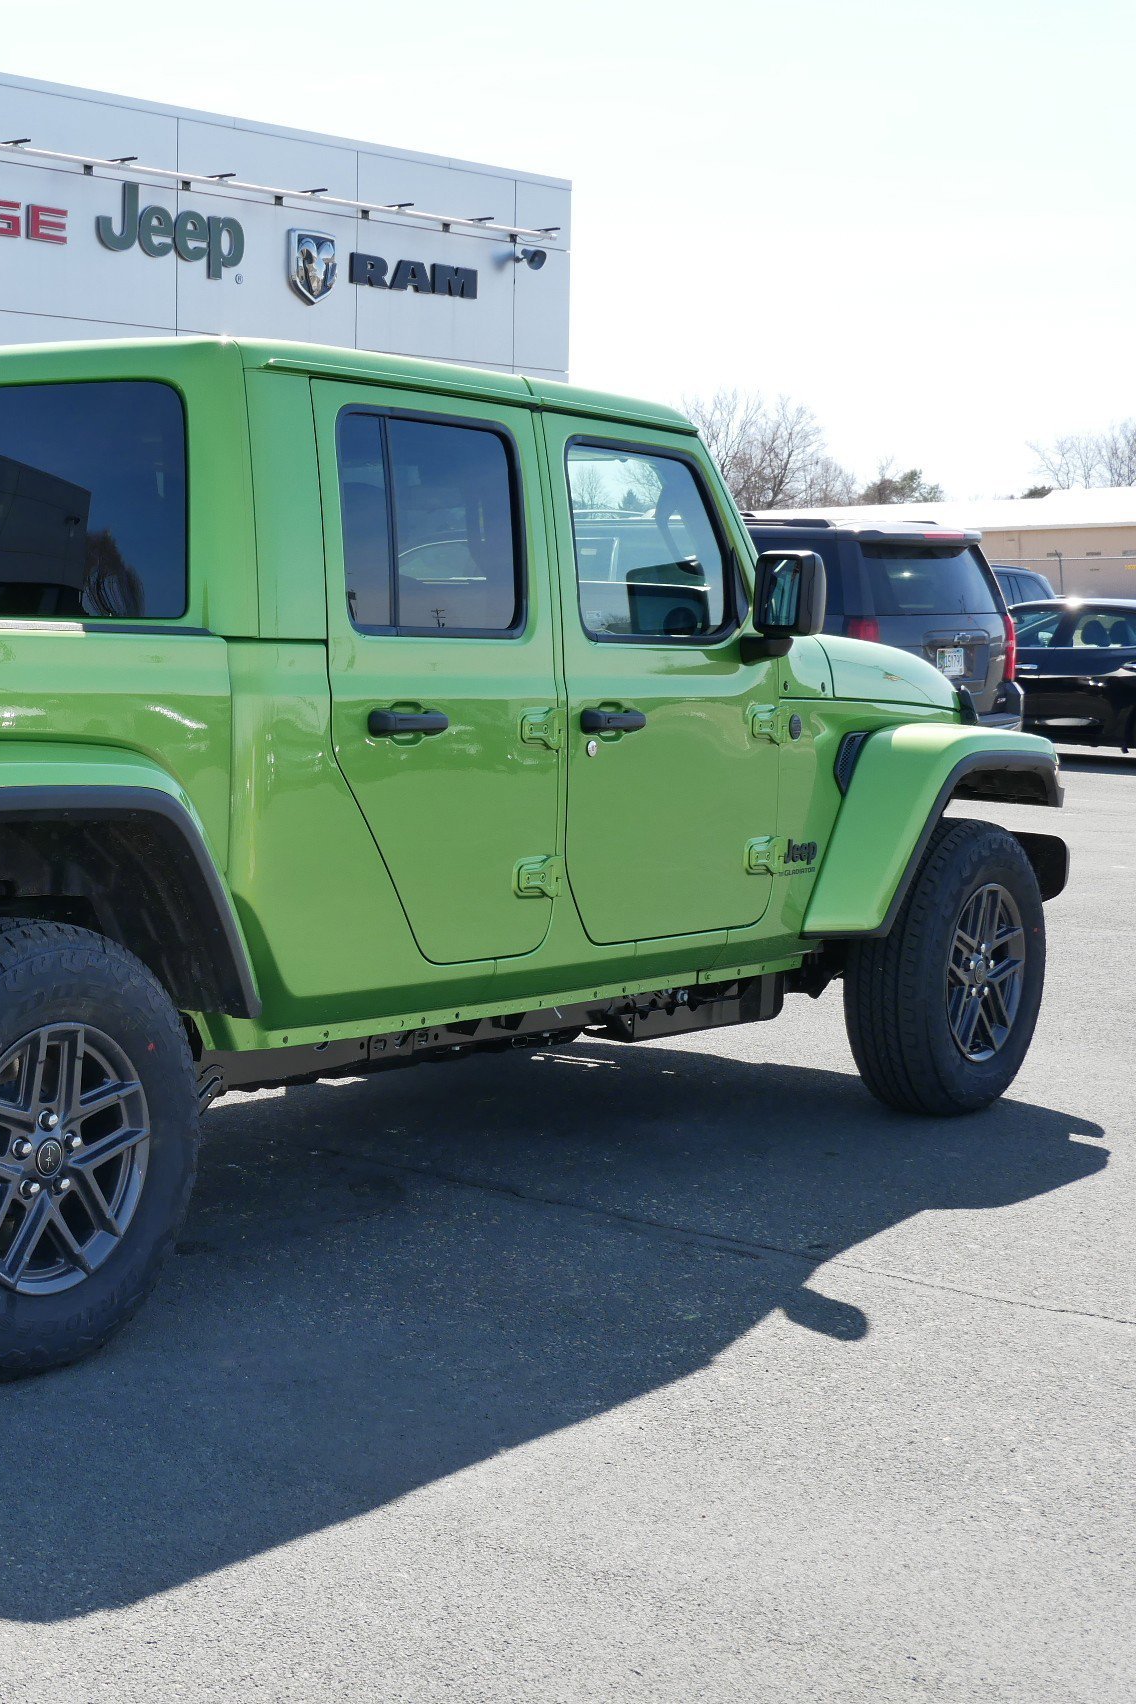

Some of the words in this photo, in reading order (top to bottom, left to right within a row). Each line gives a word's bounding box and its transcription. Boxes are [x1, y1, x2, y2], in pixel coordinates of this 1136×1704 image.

[95, 181, 245, 280] Jeep
[349, 252, 478, 299] RAM
[784, 839, 818, 865] Jeep
[784, 866, 816, 877] GLADIATOR
